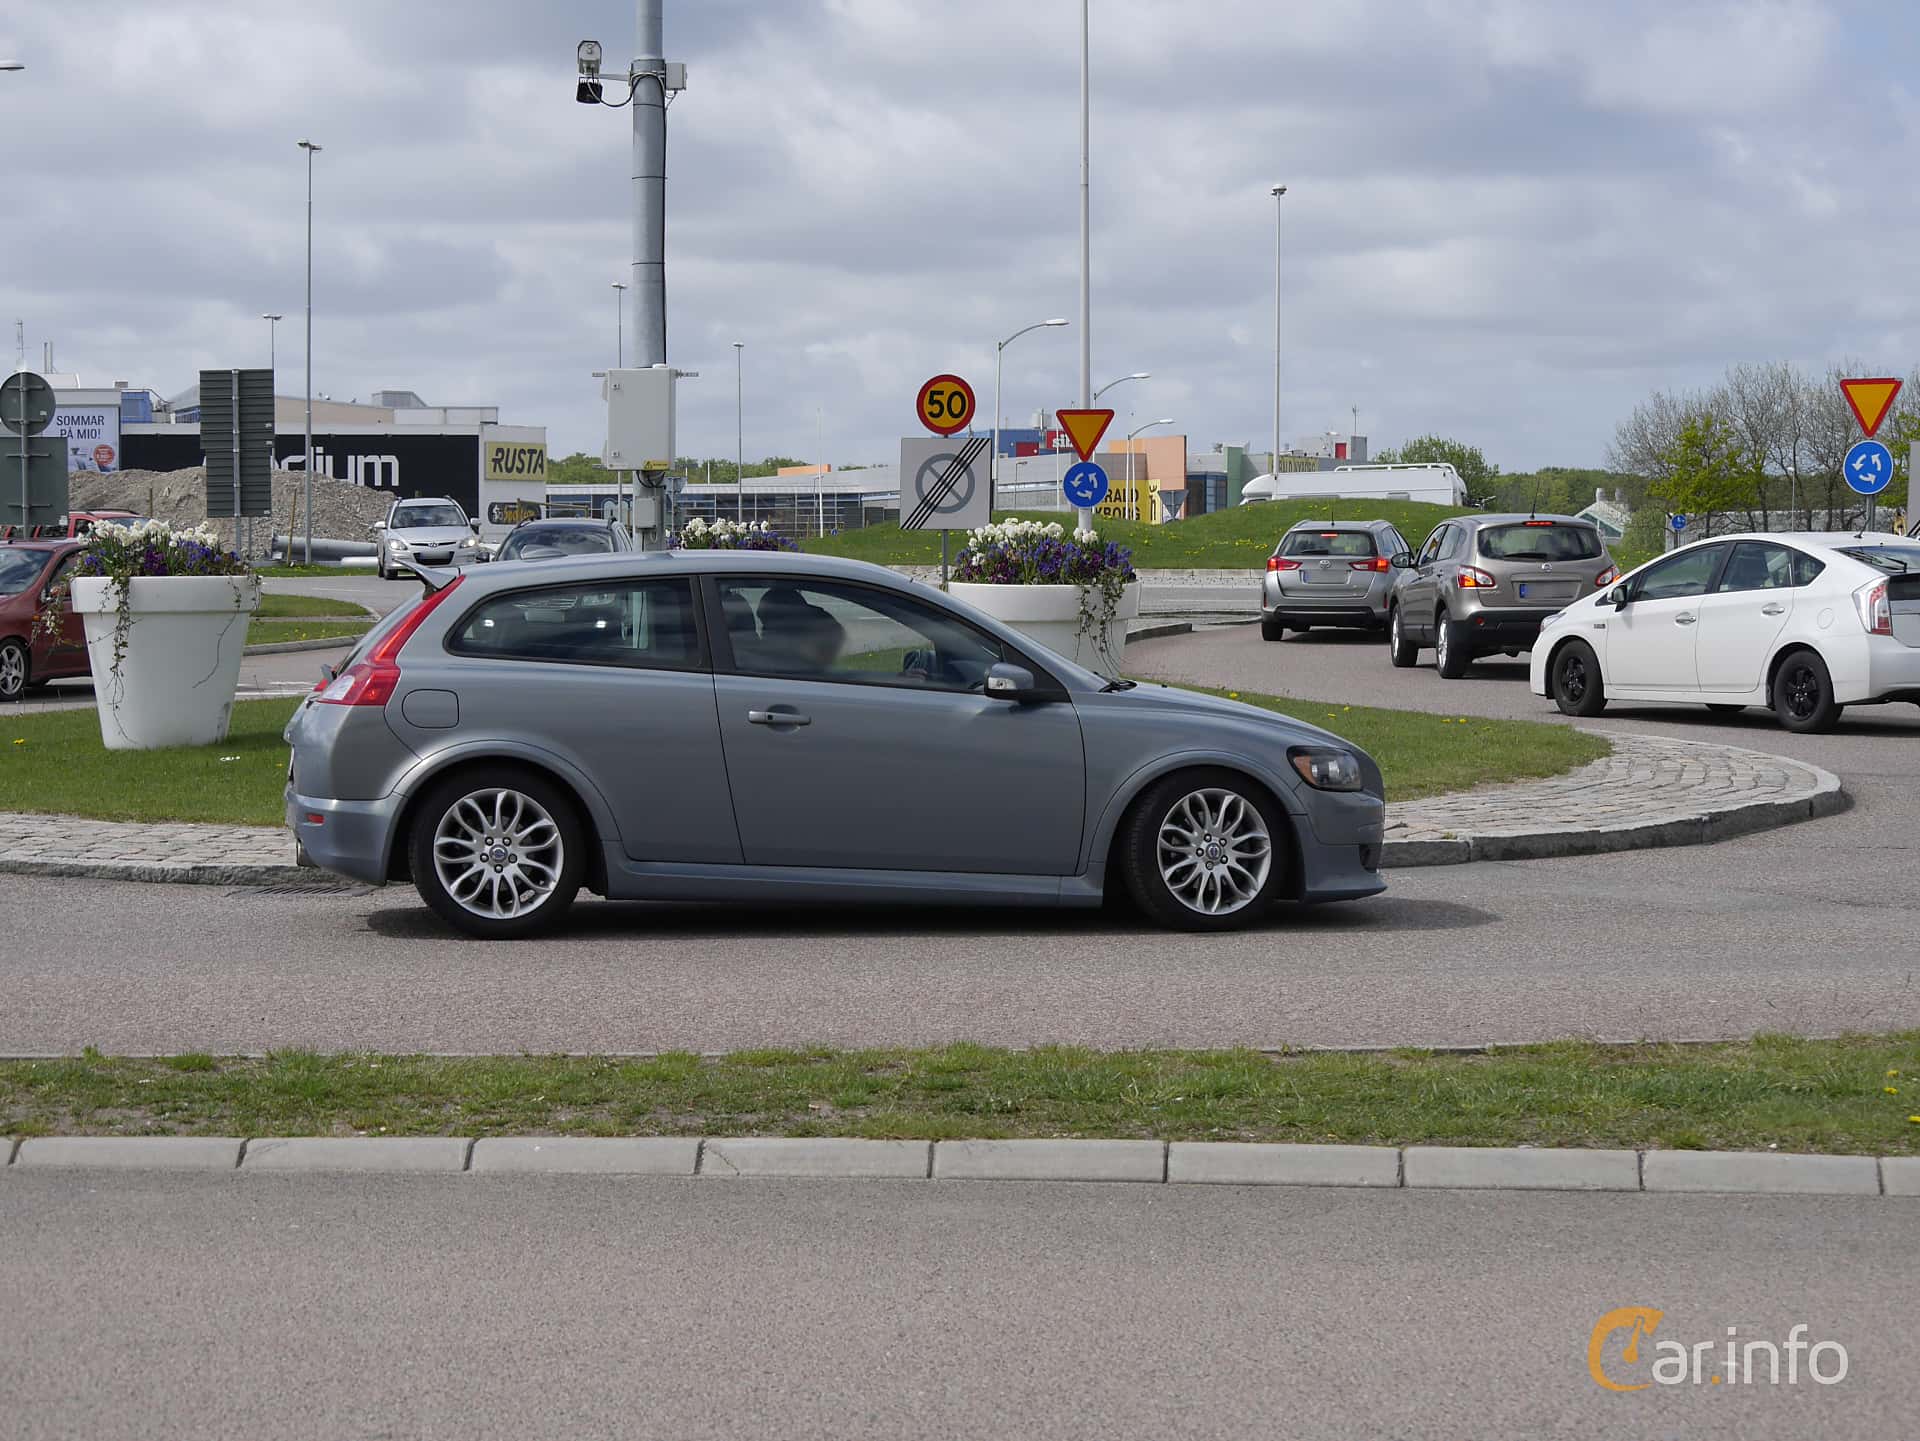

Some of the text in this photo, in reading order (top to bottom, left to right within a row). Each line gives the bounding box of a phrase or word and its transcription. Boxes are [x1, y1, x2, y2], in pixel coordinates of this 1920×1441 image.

[927, 390, 967, 419] 50
[56, 415, 105, 426] SOMMAR
[60, 426, 101, 440] PÅ MIO!
[491, 447, 544, 475] RUSTA
[1103, 487, 1140, 503] RALD
